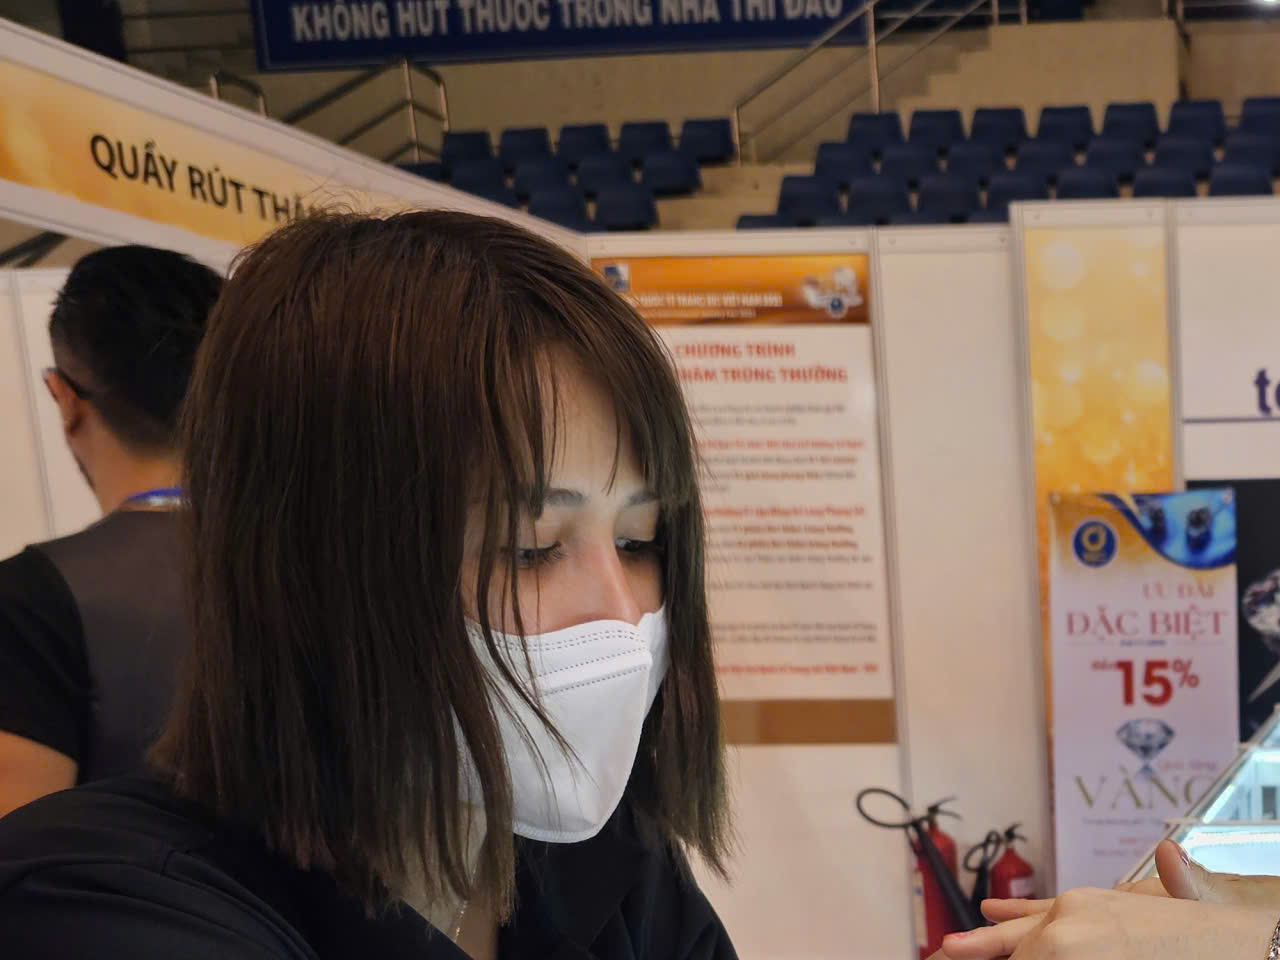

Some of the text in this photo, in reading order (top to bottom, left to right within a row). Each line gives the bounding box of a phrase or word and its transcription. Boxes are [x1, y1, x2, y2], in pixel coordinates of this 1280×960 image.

[187, 165, 245, 214] RÚT
[252, 186, 322, 222] TH
[1065, 603, 1229, 641] ĐẶC BIỆT
[1115, 657, 1200, 707] 15%
